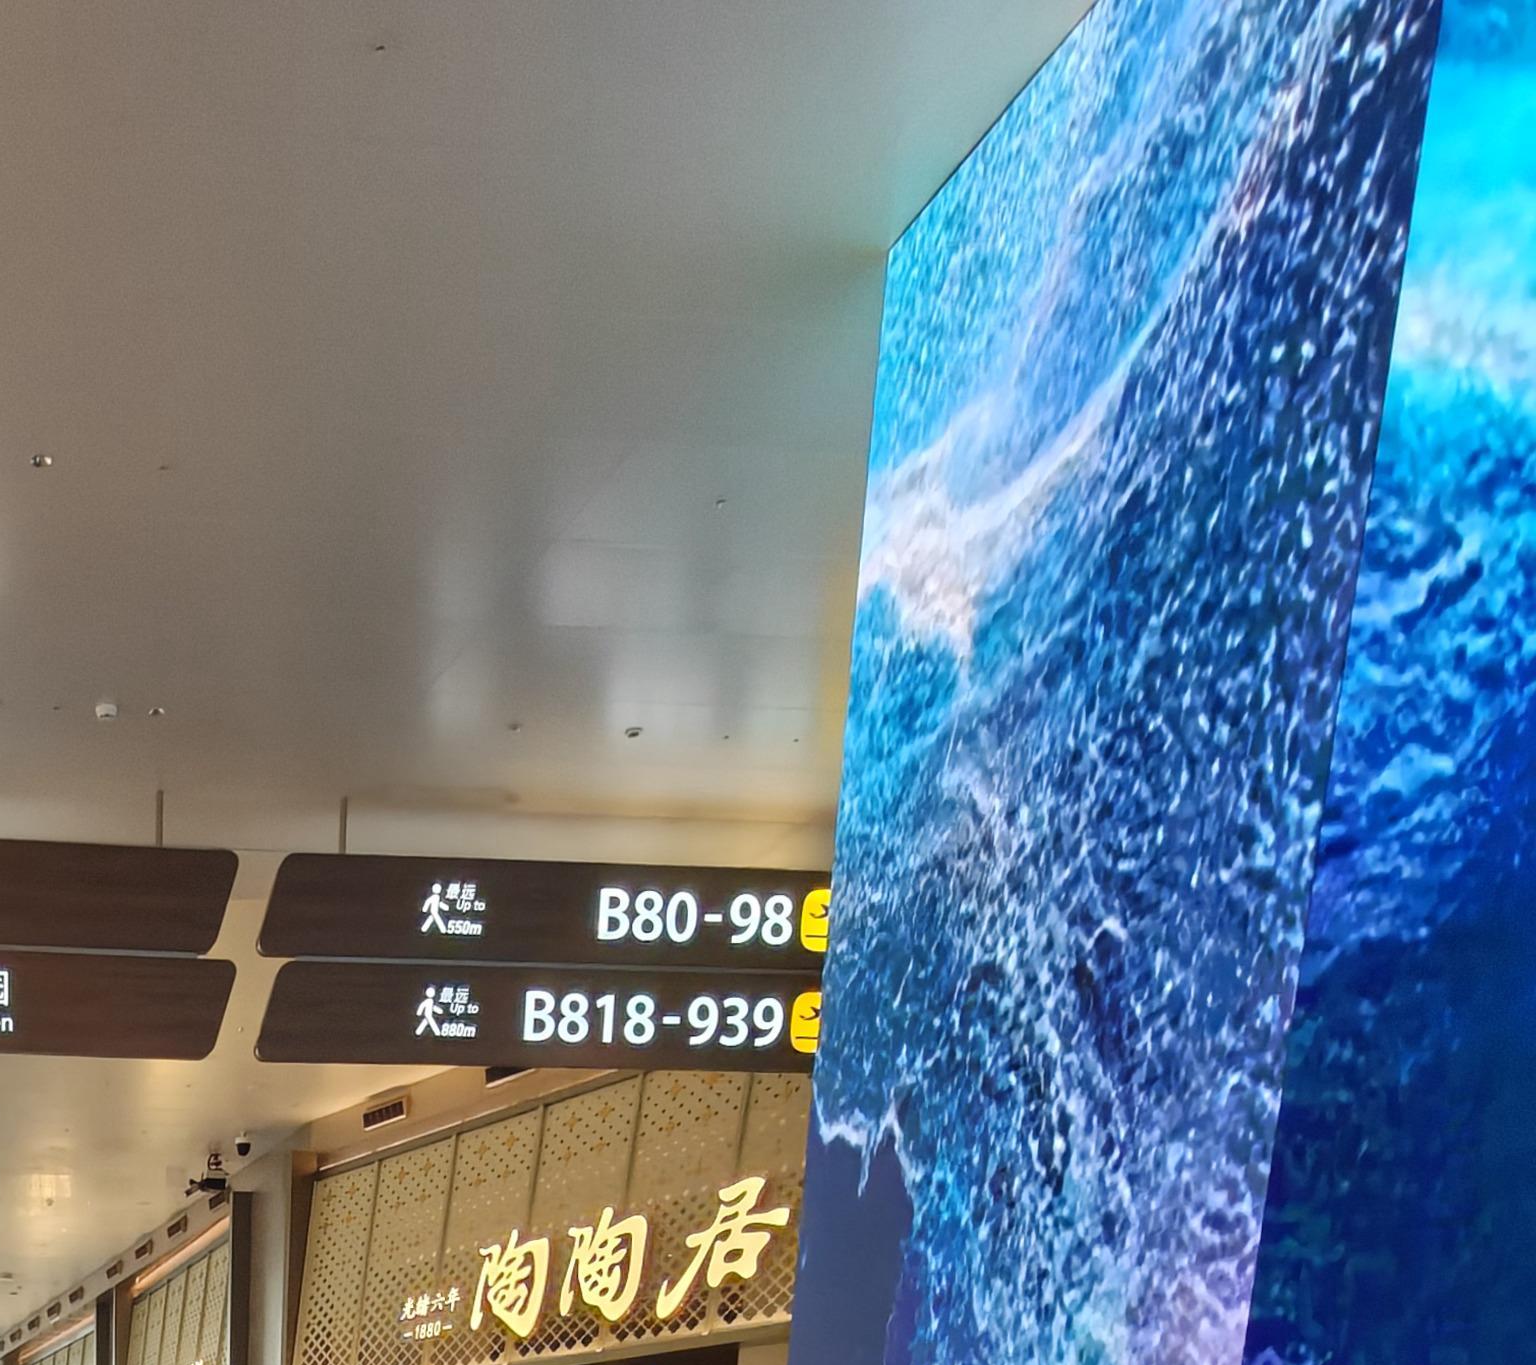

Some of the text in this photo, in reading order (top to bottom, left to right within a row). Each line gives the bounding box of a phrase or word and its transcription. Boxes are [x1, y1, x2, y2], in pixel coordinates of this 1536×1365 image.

[445, 882, 477, 900] 最远
[456, 899, 486, 913] Up to
[596, 887, 794, 946] B80-98
[447, 919, 482, 935] 550m
[439, 986, 470, 1004] 最远
[450, 1002, 480, 1016] Up to
[522, 989, 784, 1047] B818-939
[441, 1022, 476, 1038] 880m
[470, 1175, 792, 1338] 陶陶居
